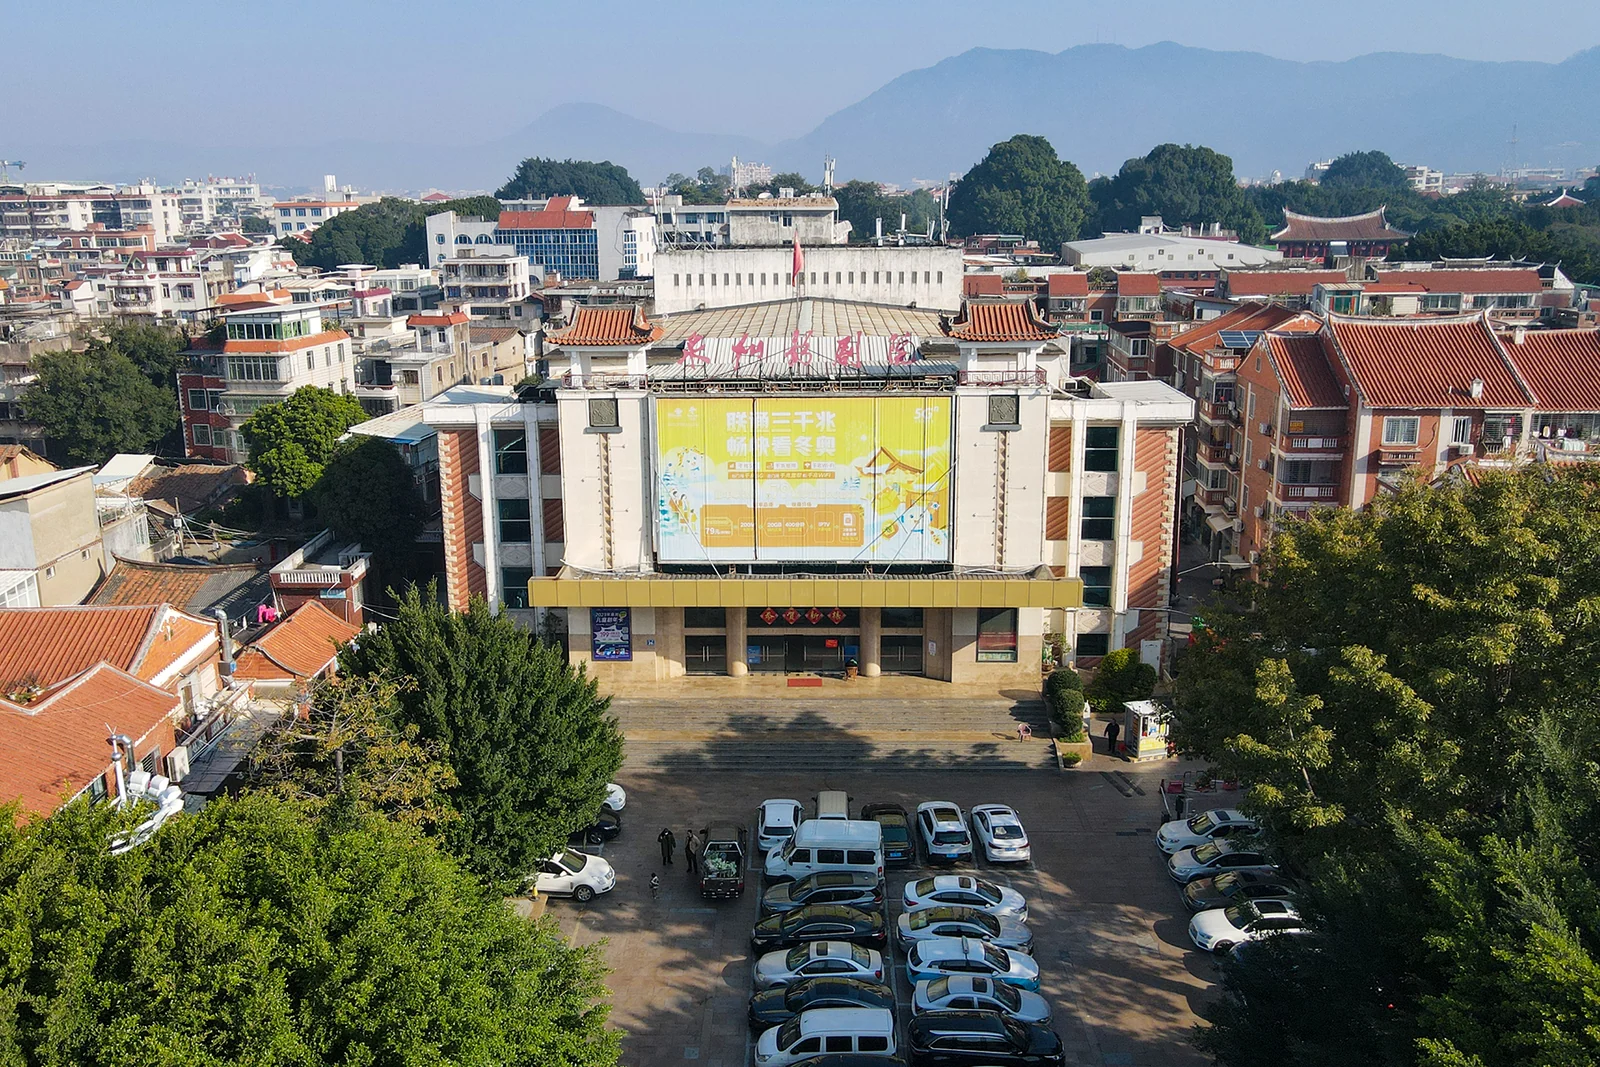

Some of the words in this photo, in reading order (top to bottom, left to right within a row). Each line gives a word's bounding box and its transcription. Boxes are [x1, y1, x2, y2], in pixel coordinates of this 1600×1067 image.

[677, 329, 916, 370] 泉州影剧院
[726, 411, 836, 433] 联通三千兆
[726, 435, 836, 457] 畅快看冬奥
